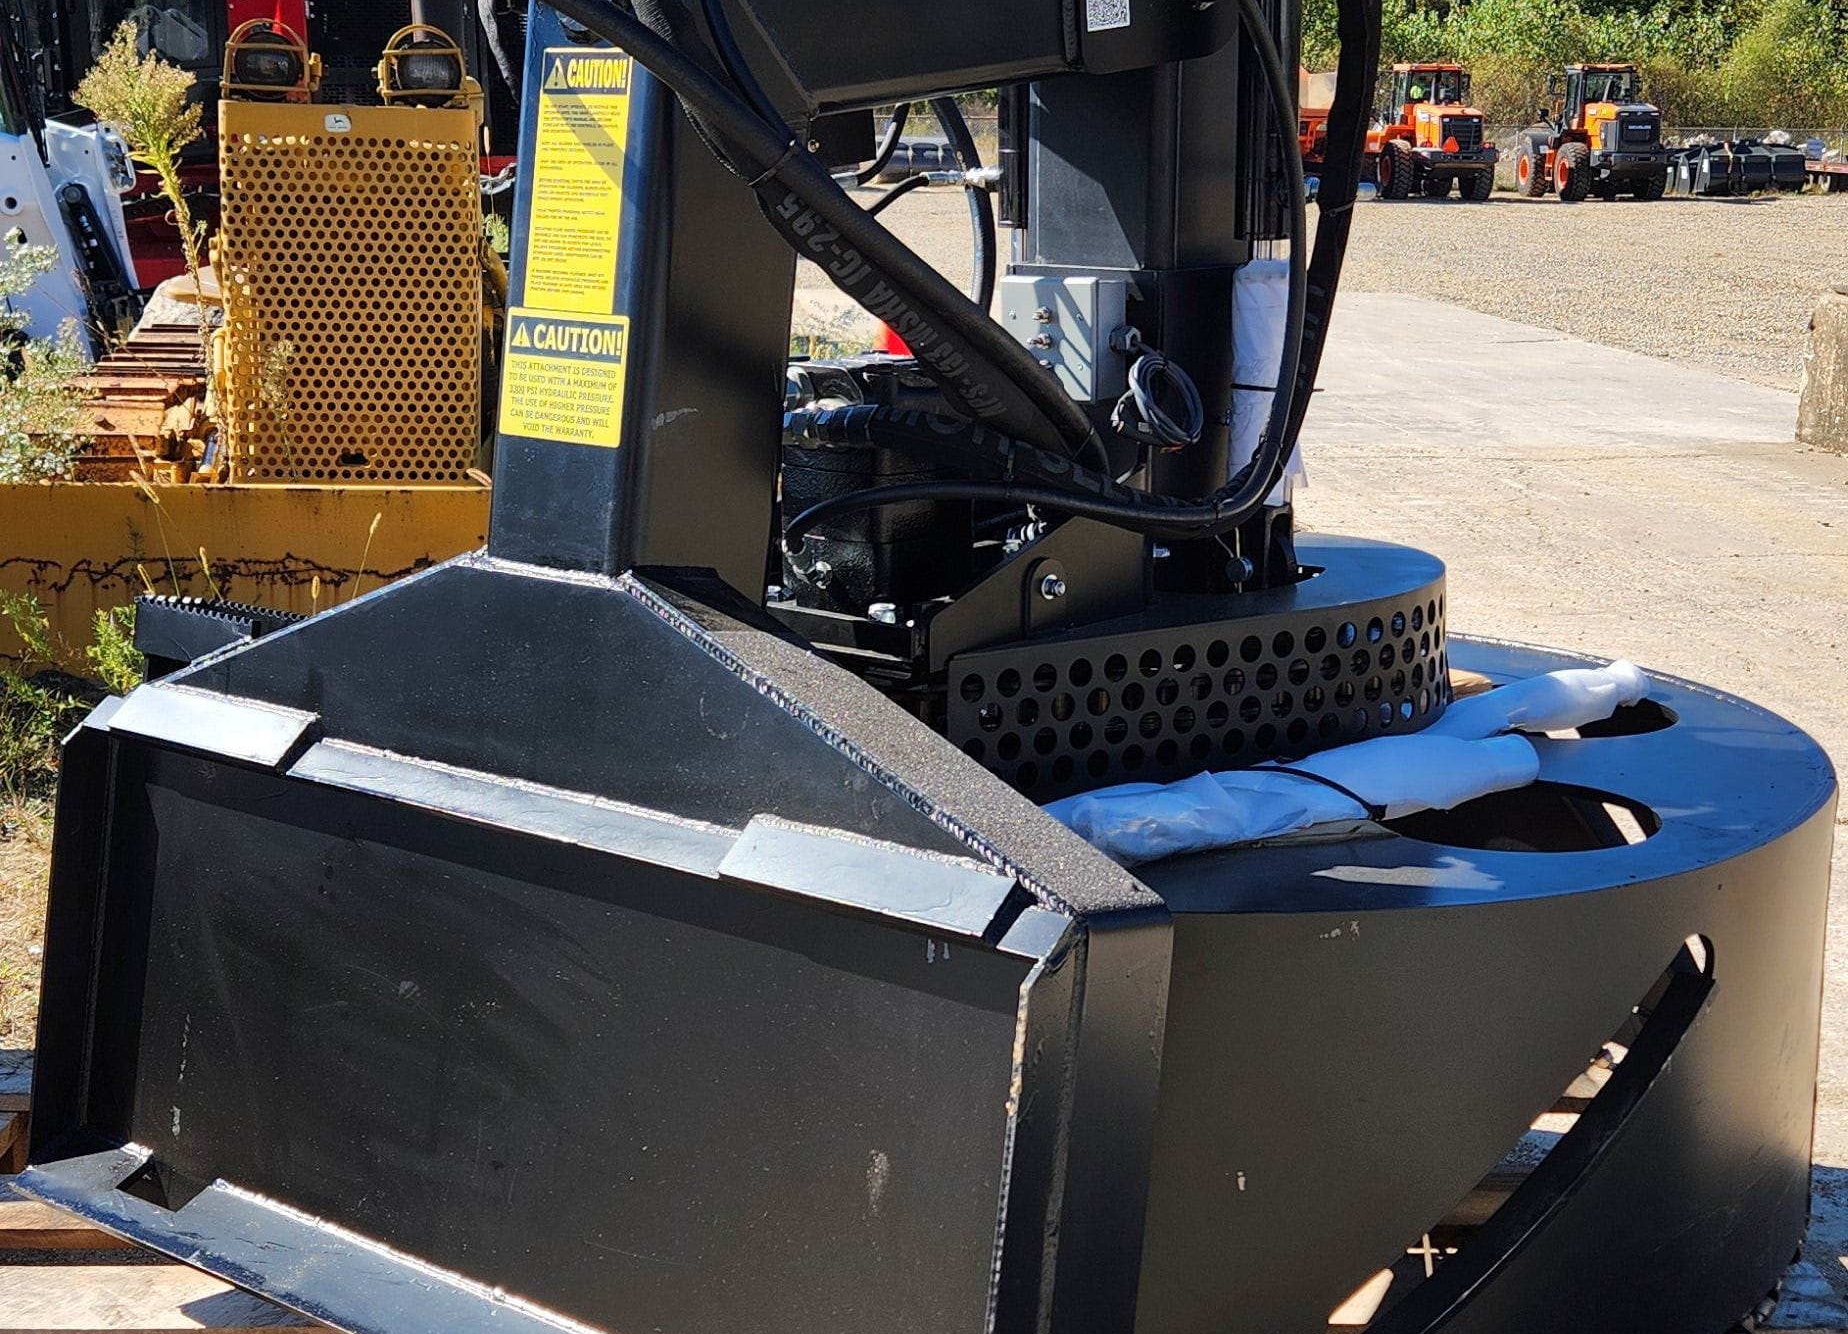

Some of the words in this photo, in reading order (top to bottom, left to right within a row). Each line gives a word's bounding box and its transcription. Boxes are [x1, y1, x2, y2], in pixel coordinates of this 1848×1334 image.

[566, 58, 628, 89] CAUTION!
[775, 191, 873, 287] IC-295
[862, 280, 939, 349] MSHA
[533, 323, 623, 356] CAUTION!
[512, 360, 527, 370] THIS
[528, 362, 572, 374] ATTACHMENT
[573, 366, 581, 375] IS
[581, 367, 616, 378] DESIGNED
[509, 372, 518, 381] TO
[519, 373, 527, 382] BE
[529, 374, 546, 384] USED
[547, 376, 566, 386] WITH
[567, 379, 572, 387] A
[573, 379, 607, 390] MAXIMUM
[608, 382, 617, 391] OF
[526, 386, 538, 395] PSI
[539, 387, 577, 399] HYDRAULIC
[511, 396, 524, 406] THE
[525, 398, 538, 407] USE
[539, 399, 548, 408] OF
[549, 400, 575, 411] HIGHER
[576, 403, 611, 415] PRESSURE
[510, 408, 524, 418] CAN
[525, 410, 534, 419] BE
[534, 411, 576, 423] DANGEROUS
[575, 415, 591, 426] AND
[592, 418, 609, 428] WILL
[523, 422, 540, 432] VOID
[541, 424, 554, 434] THE
[555, 426, 595, 439] WARRANTY.
